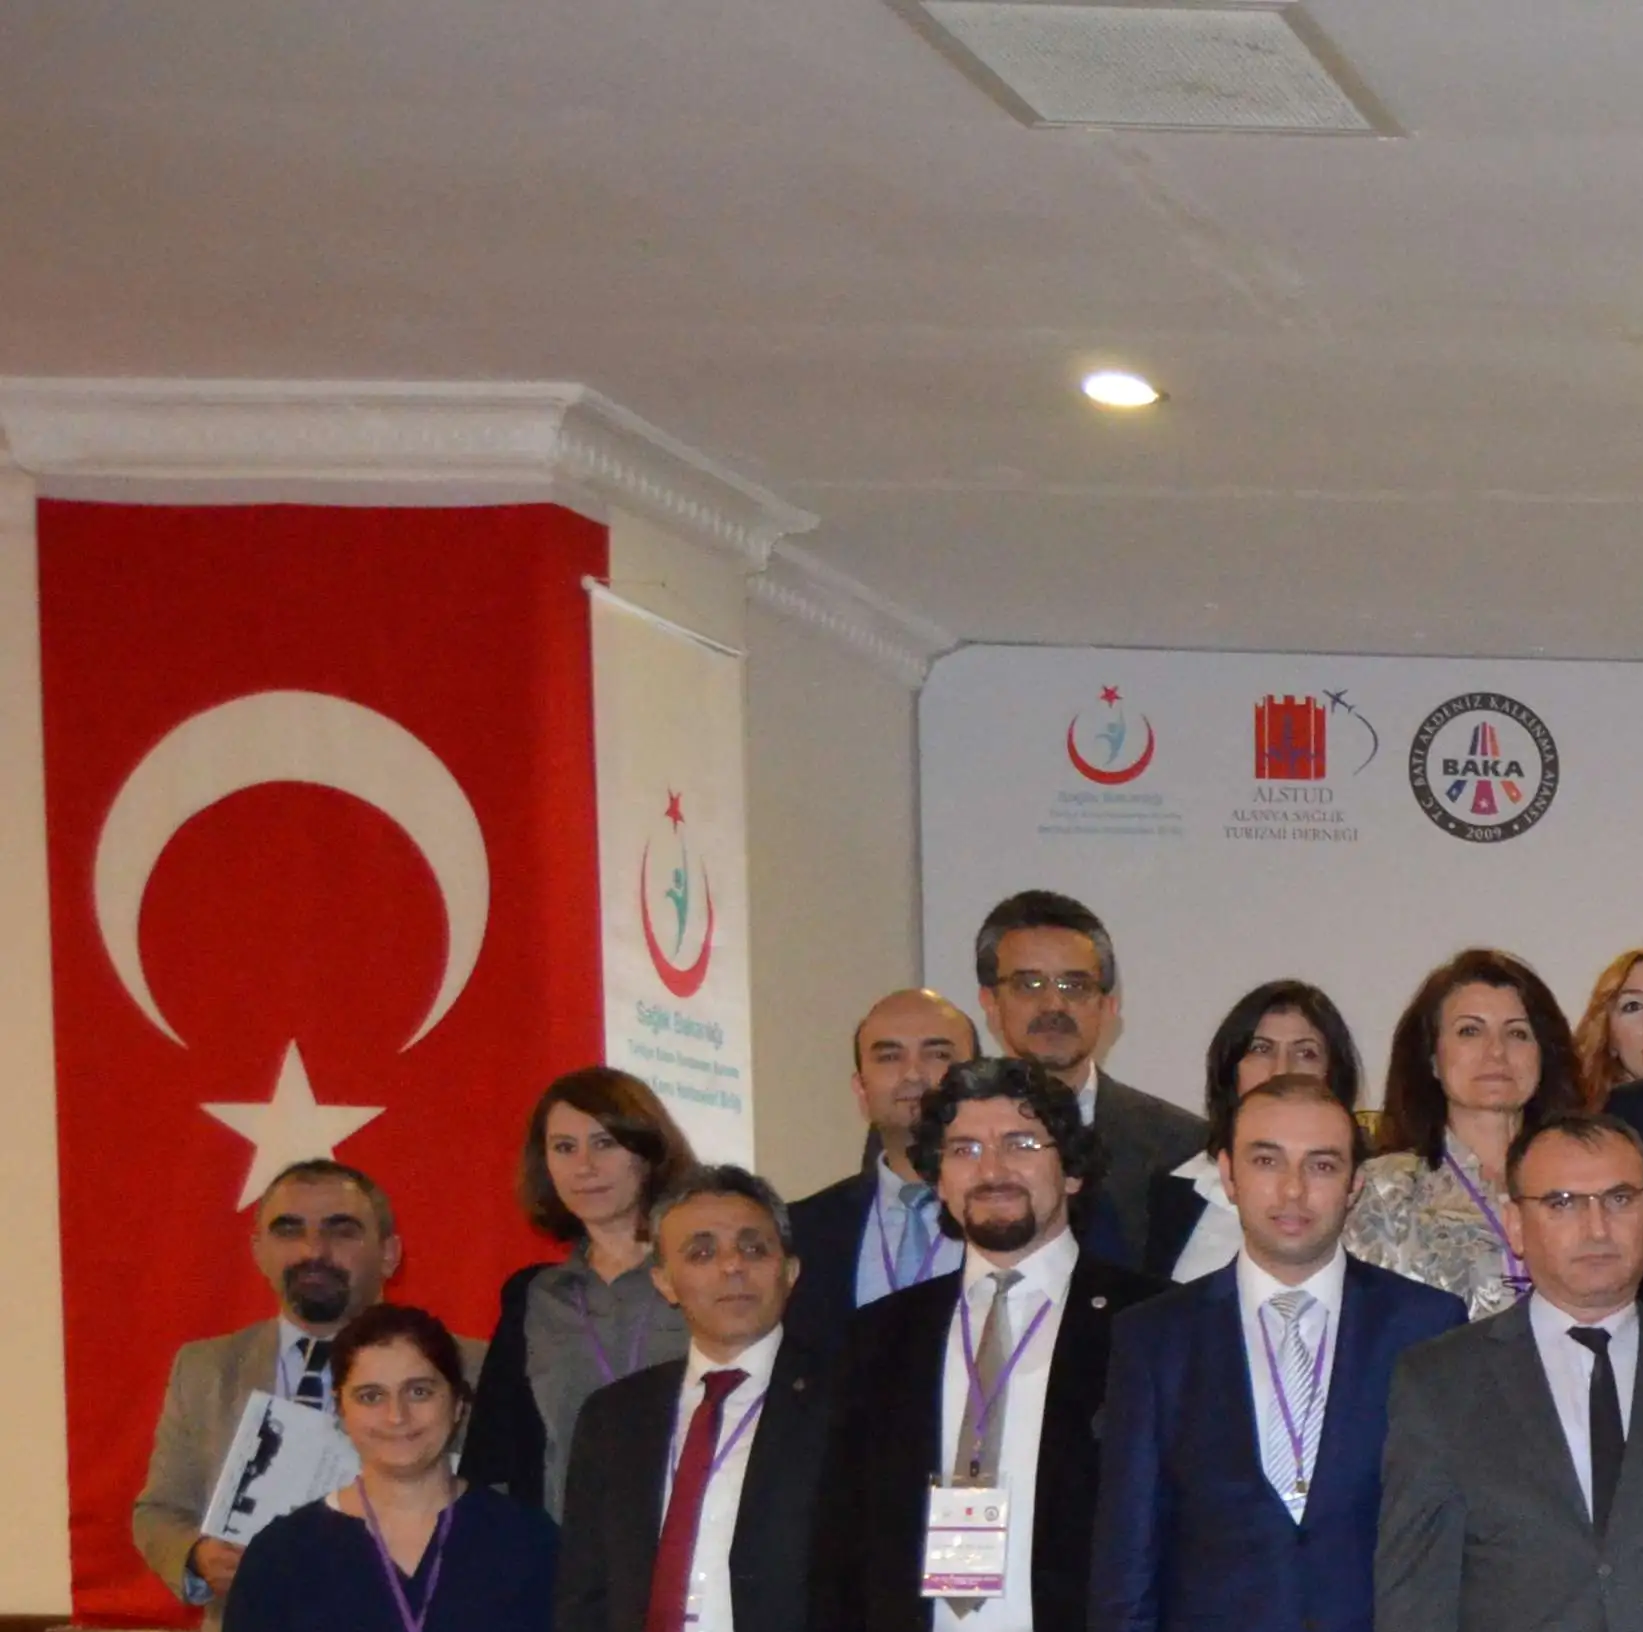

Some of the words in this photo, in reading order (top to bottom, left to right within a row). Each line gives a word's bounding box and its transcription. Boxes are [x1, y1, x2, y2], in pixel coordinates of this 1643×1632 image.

[1442, 757, 1526, 778] BAKA
[1252, 786, 1335, 804] ALSTUD
[1465, 826, 1503, 841] 2009
